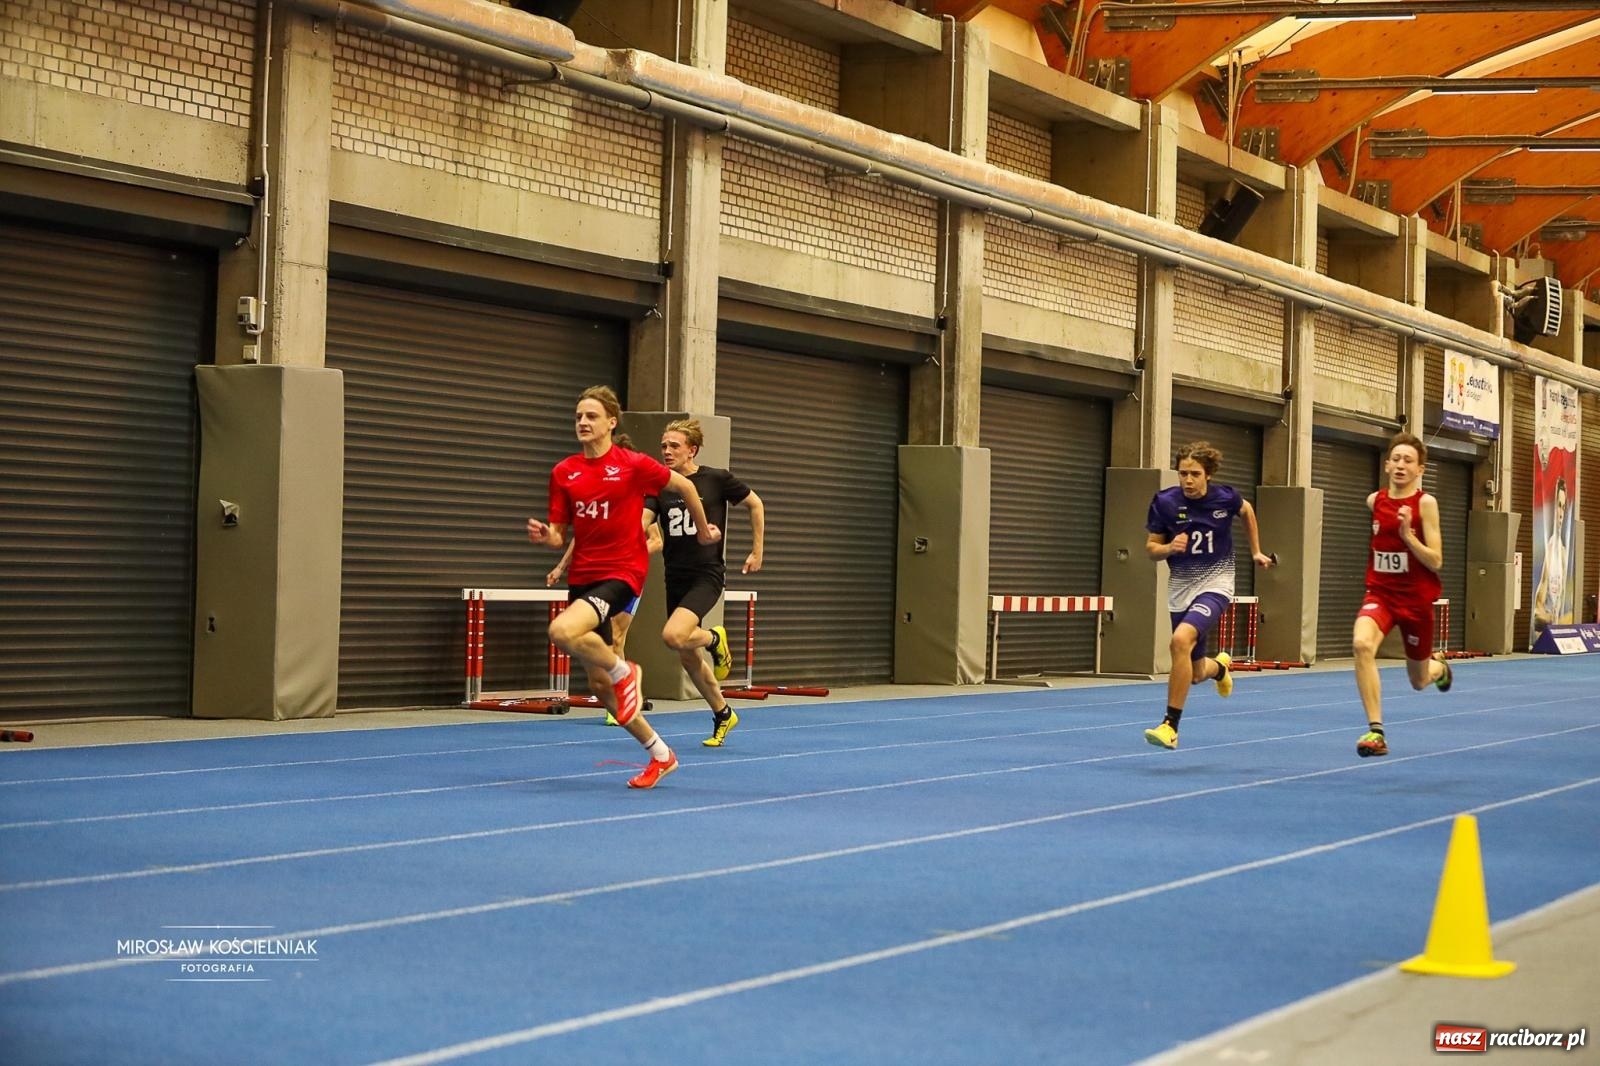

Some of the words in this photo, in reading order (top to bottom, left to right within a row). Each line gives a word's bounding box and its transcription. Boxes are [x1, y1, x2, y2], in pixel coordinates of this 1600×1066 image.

[575, 501, 609, 519] 241
[1191, 530, 1214, 555] 21
[1377, 553, 1401, 570] 719
